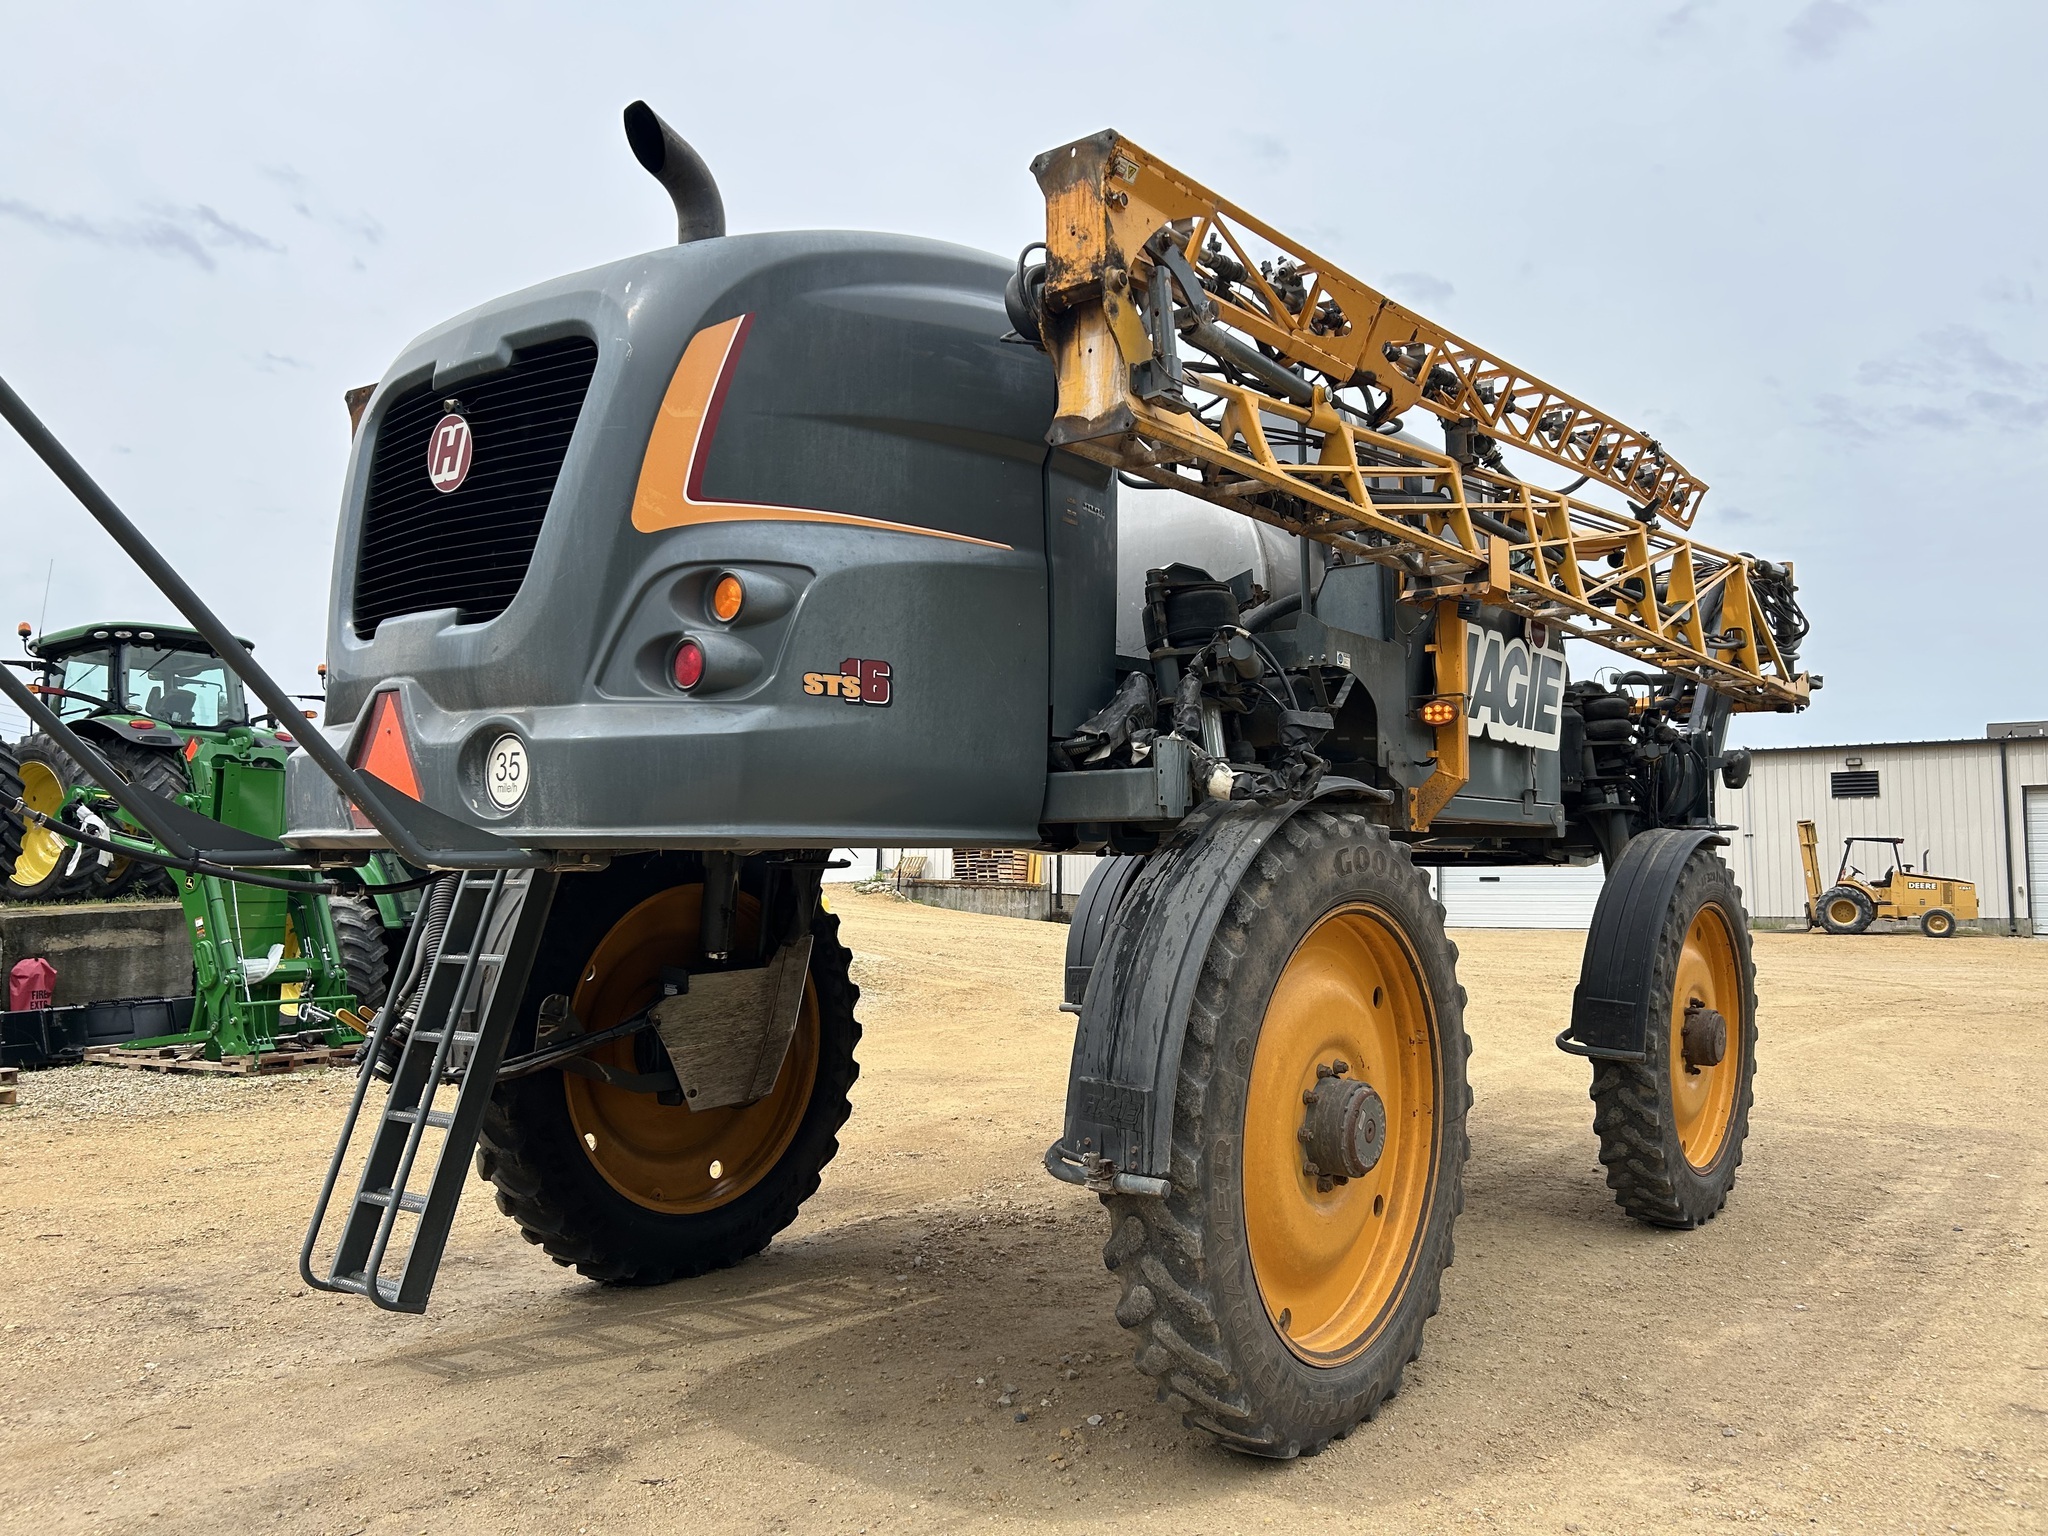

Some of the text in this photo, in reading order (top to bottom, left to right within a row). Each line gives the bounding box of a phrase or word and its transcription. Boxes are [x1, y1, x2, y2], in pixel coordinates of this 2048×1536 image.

[496, 752, 520, 781] 35
[497, 783, 517, 793] mile/h
[31, 990, 51, 1000] FIRE
